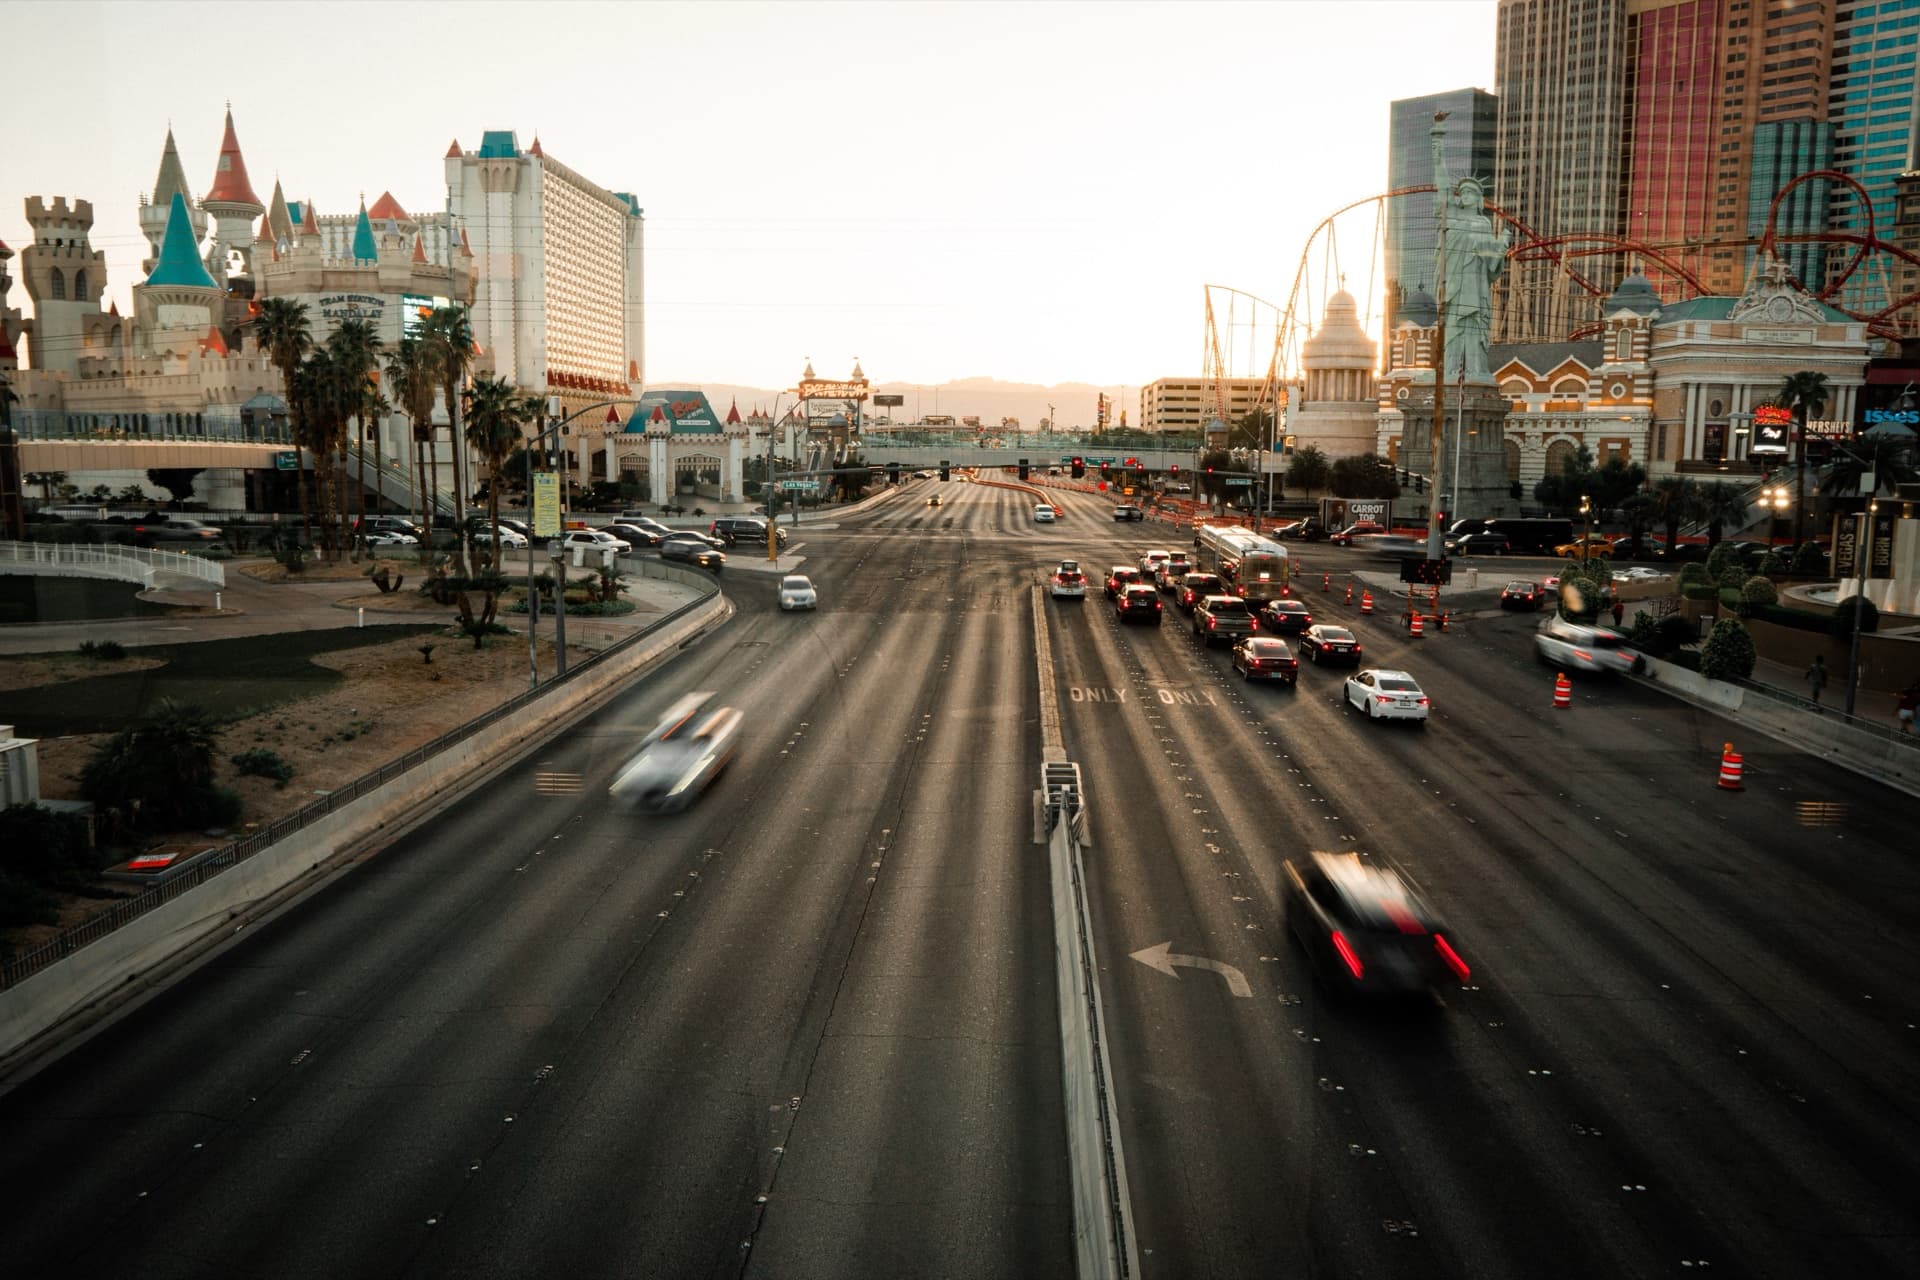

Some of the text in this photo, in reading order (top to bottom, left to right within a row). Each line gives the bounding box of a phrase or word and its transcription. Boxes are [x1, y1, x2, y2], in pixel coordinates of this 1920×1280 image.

[319, 295, 345, 307] TRAM
[322, 309, 383, 318] MANDALAY
[803, 383, 865, 398] EXCALIBUR
[1351, 504, 1384, 514] CARROT
[1358, 513, 1375, 521] TOP
[1837, 533, 1855, 568] VEGAS
[1874, 537, 1891, 566] BORN
[1070, 687, 1127, 703] ONLY
[1157, 689, 1218, 706] ONLY
